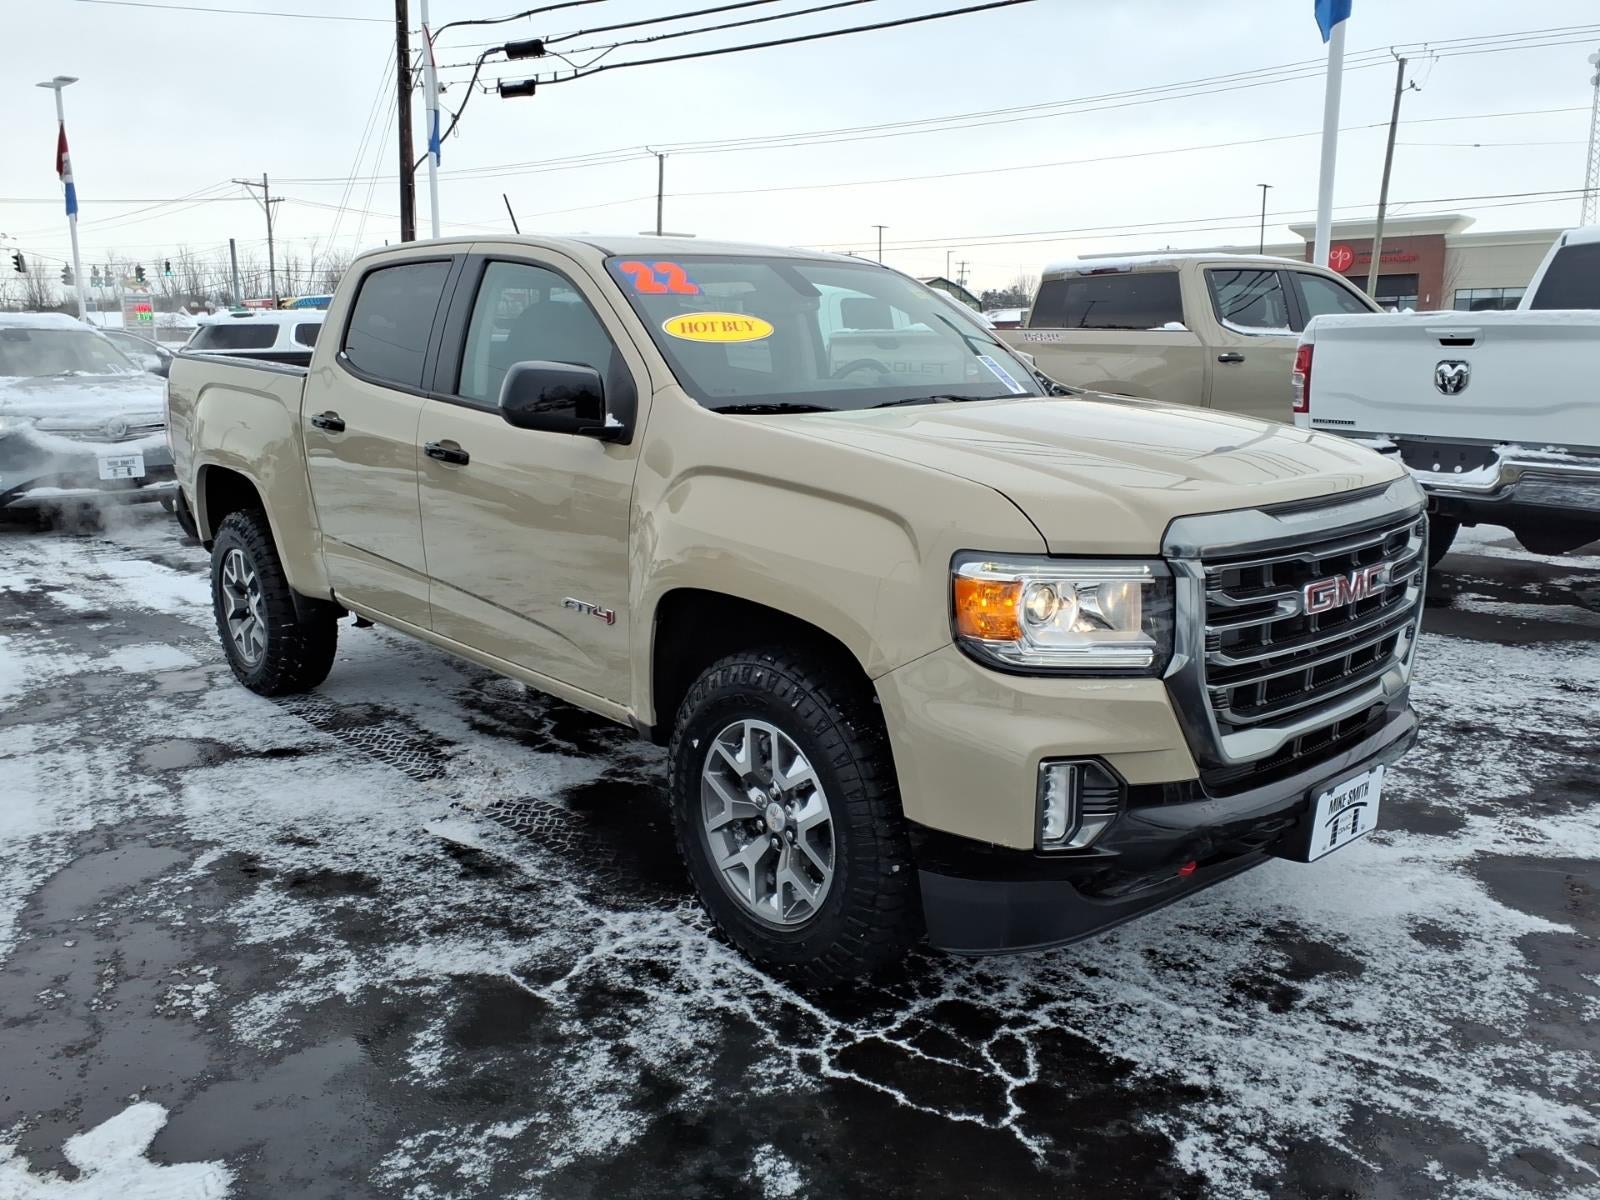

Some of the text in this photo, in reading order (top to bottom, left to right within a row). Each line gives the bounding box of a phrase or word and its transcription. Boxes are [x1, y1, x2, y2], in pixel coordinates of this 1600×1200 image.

[619, 260, 699, 295] 22
[680, 320, 755, 334] HOT BUY
[1303, 561, 1386, 615] GMC
[561, 596, 615, 625] AT4
[1328, 781, 1370, 816] MIKE SMITH
